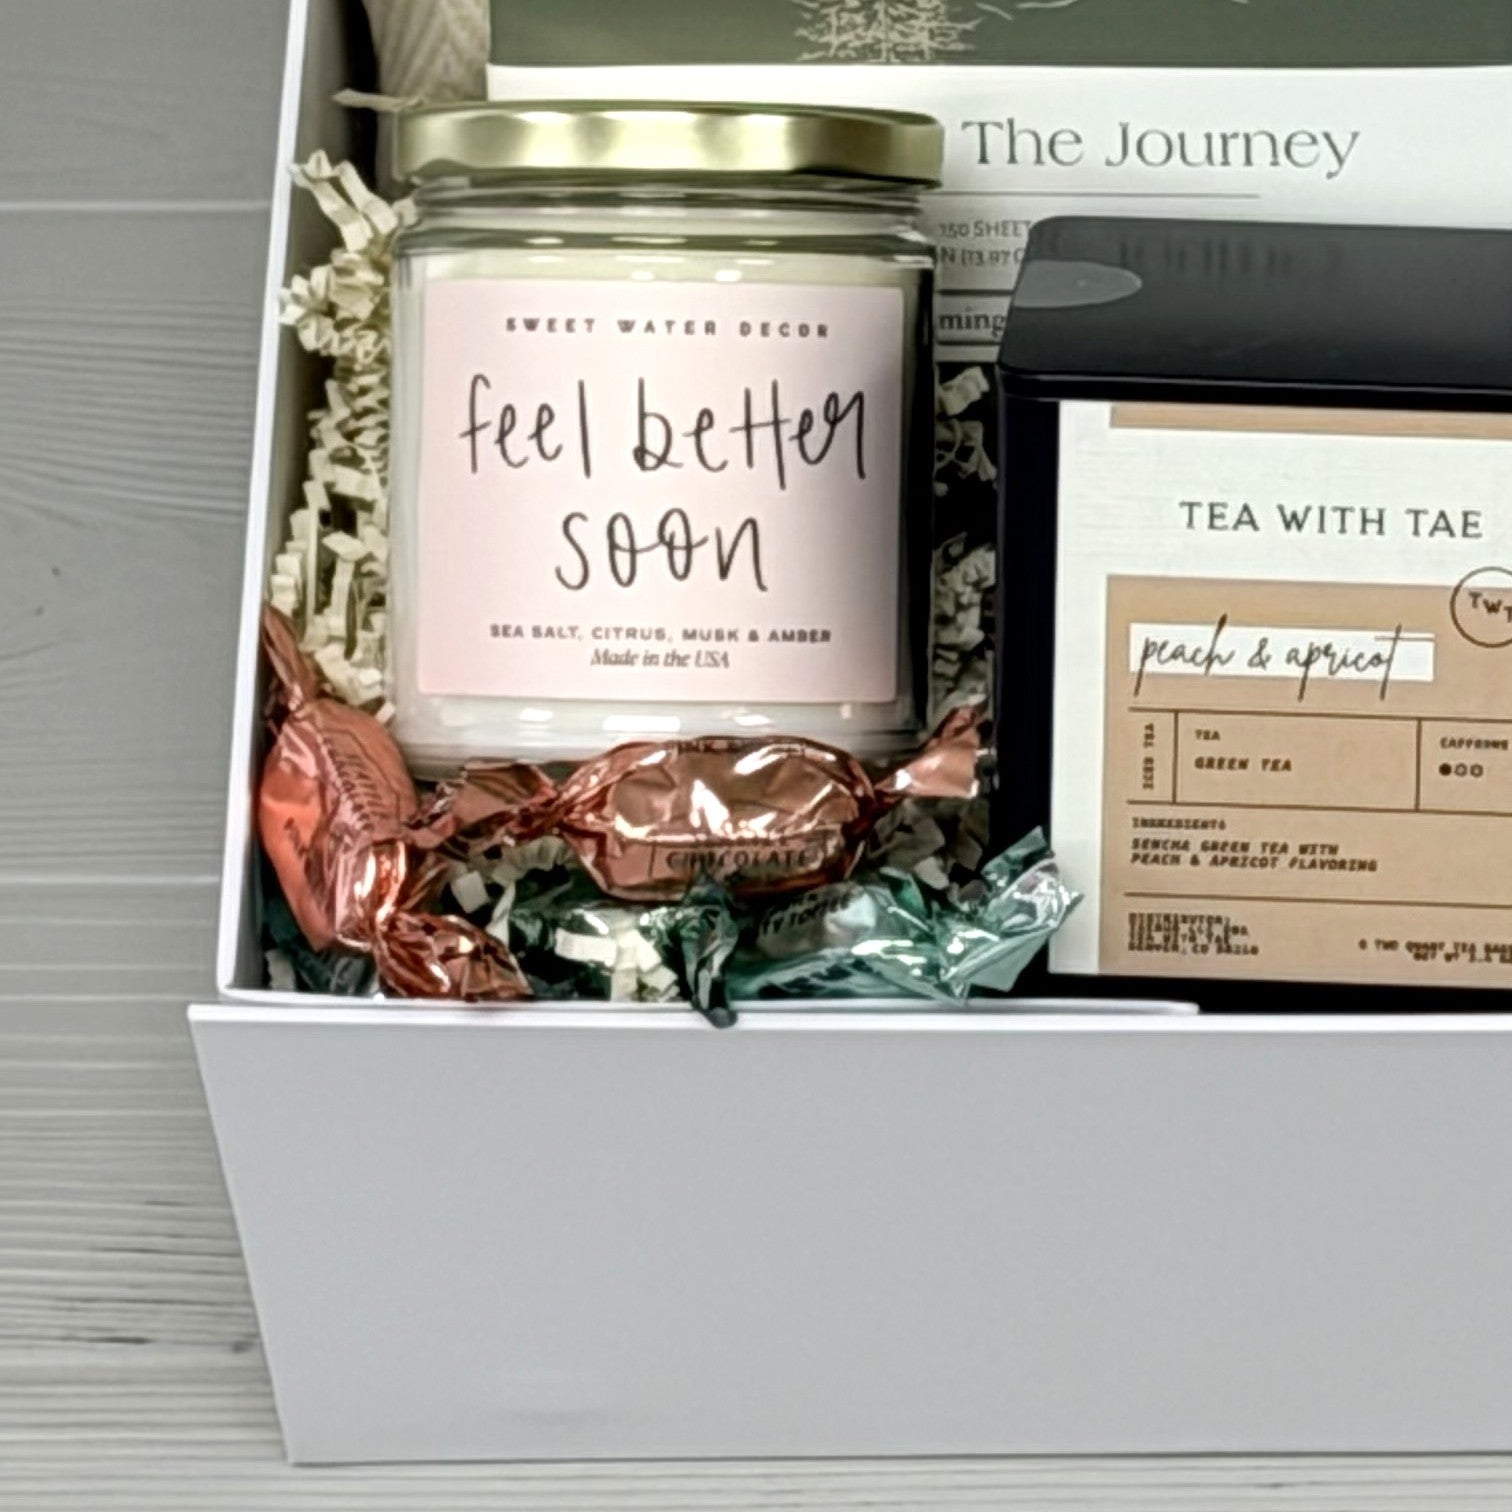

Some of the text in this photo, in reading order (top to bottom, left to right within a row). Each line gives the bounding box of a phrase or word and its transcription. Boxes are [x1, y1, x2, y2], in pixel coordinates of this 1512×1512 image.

[961, 117, 1361, 180] The Journey
[973, 219, 1032, 238] SHEET
[506, 317, 830, 339] SWEET WATER DECOR
[937, 305, 1006, 339] ming
[459, 373, 867, 490] feel better
[1179, 500, 1484, 539] TEA WITH TAE
[555, 508, 768, 592] soon
[490, 624, 832, 644] SEA SALT, CITRUS, MUSK & AMBER
[590, 648, 731, 669] Made in the USA
[1133, 613, 1434, 702] peach & apricot
[1195, 729, 1221, 741] TEA
[1194, 756, 1293, 772] GREEN TEA
[1131, 838, 1340, 856] SENCHA GREEN TEA WITH
[1130, 852, 1379, 873] PEACH & APRICOT FLAVORING
